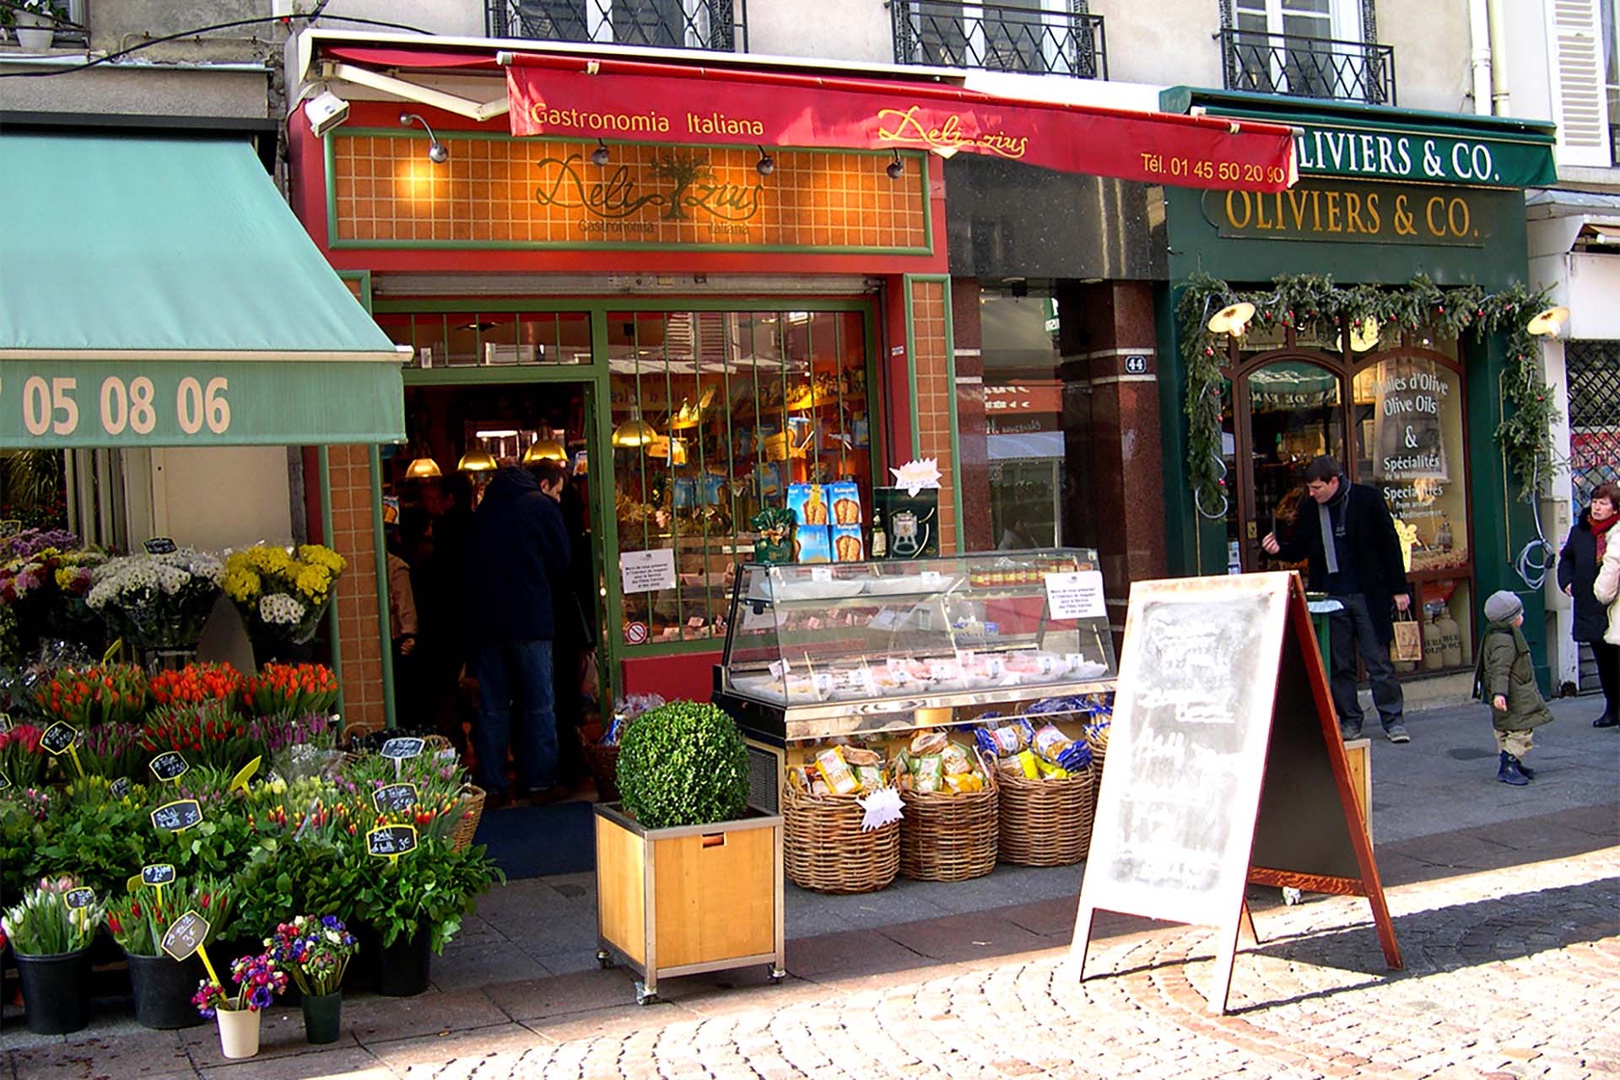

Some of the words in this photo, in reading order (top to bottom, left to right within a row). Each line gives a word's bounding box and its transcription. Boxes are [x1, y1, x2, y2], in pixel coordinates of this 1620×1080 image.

[531, 102, 670, 132] Gastronomia
[687, 112, 764, 136] Italiana
[1141, 153, 1167, 174] Tél.
[1170, 157, 1188, 176] 01
[1193, 161, 1214, 179] 45
[1218, 162, 1240, 180] 50
[1244, 163, 1264, 182] 20
[1266, 166, 1285, 183] 90
[1299, 131, 1412, 175] LIVIERS
[1423, 139, 1446, 177] &
[1451, 142, 1500, 182] CO.
[1225, 189, 1381, 234] OLIVIERS
[1393, 194, 1418, 236] &
[1425, 196, 1479, 237] CO.
[578, 220, 654, 234] Gastronomia
[1128, 358, 1143, 370] 44
[1410, 372, 1449, 396] d'Olive
[23, 376, 79, 436] 05
[100, 376, 156, 435] 08
[177, 376, 231, 435] 06
[1384, 396, 1413, 417] Olive
[1415, 394, 1437, 414] Oils
[1405, 425, 1418, 448] &
[1384, 454, 1440, 472] Spécialités
